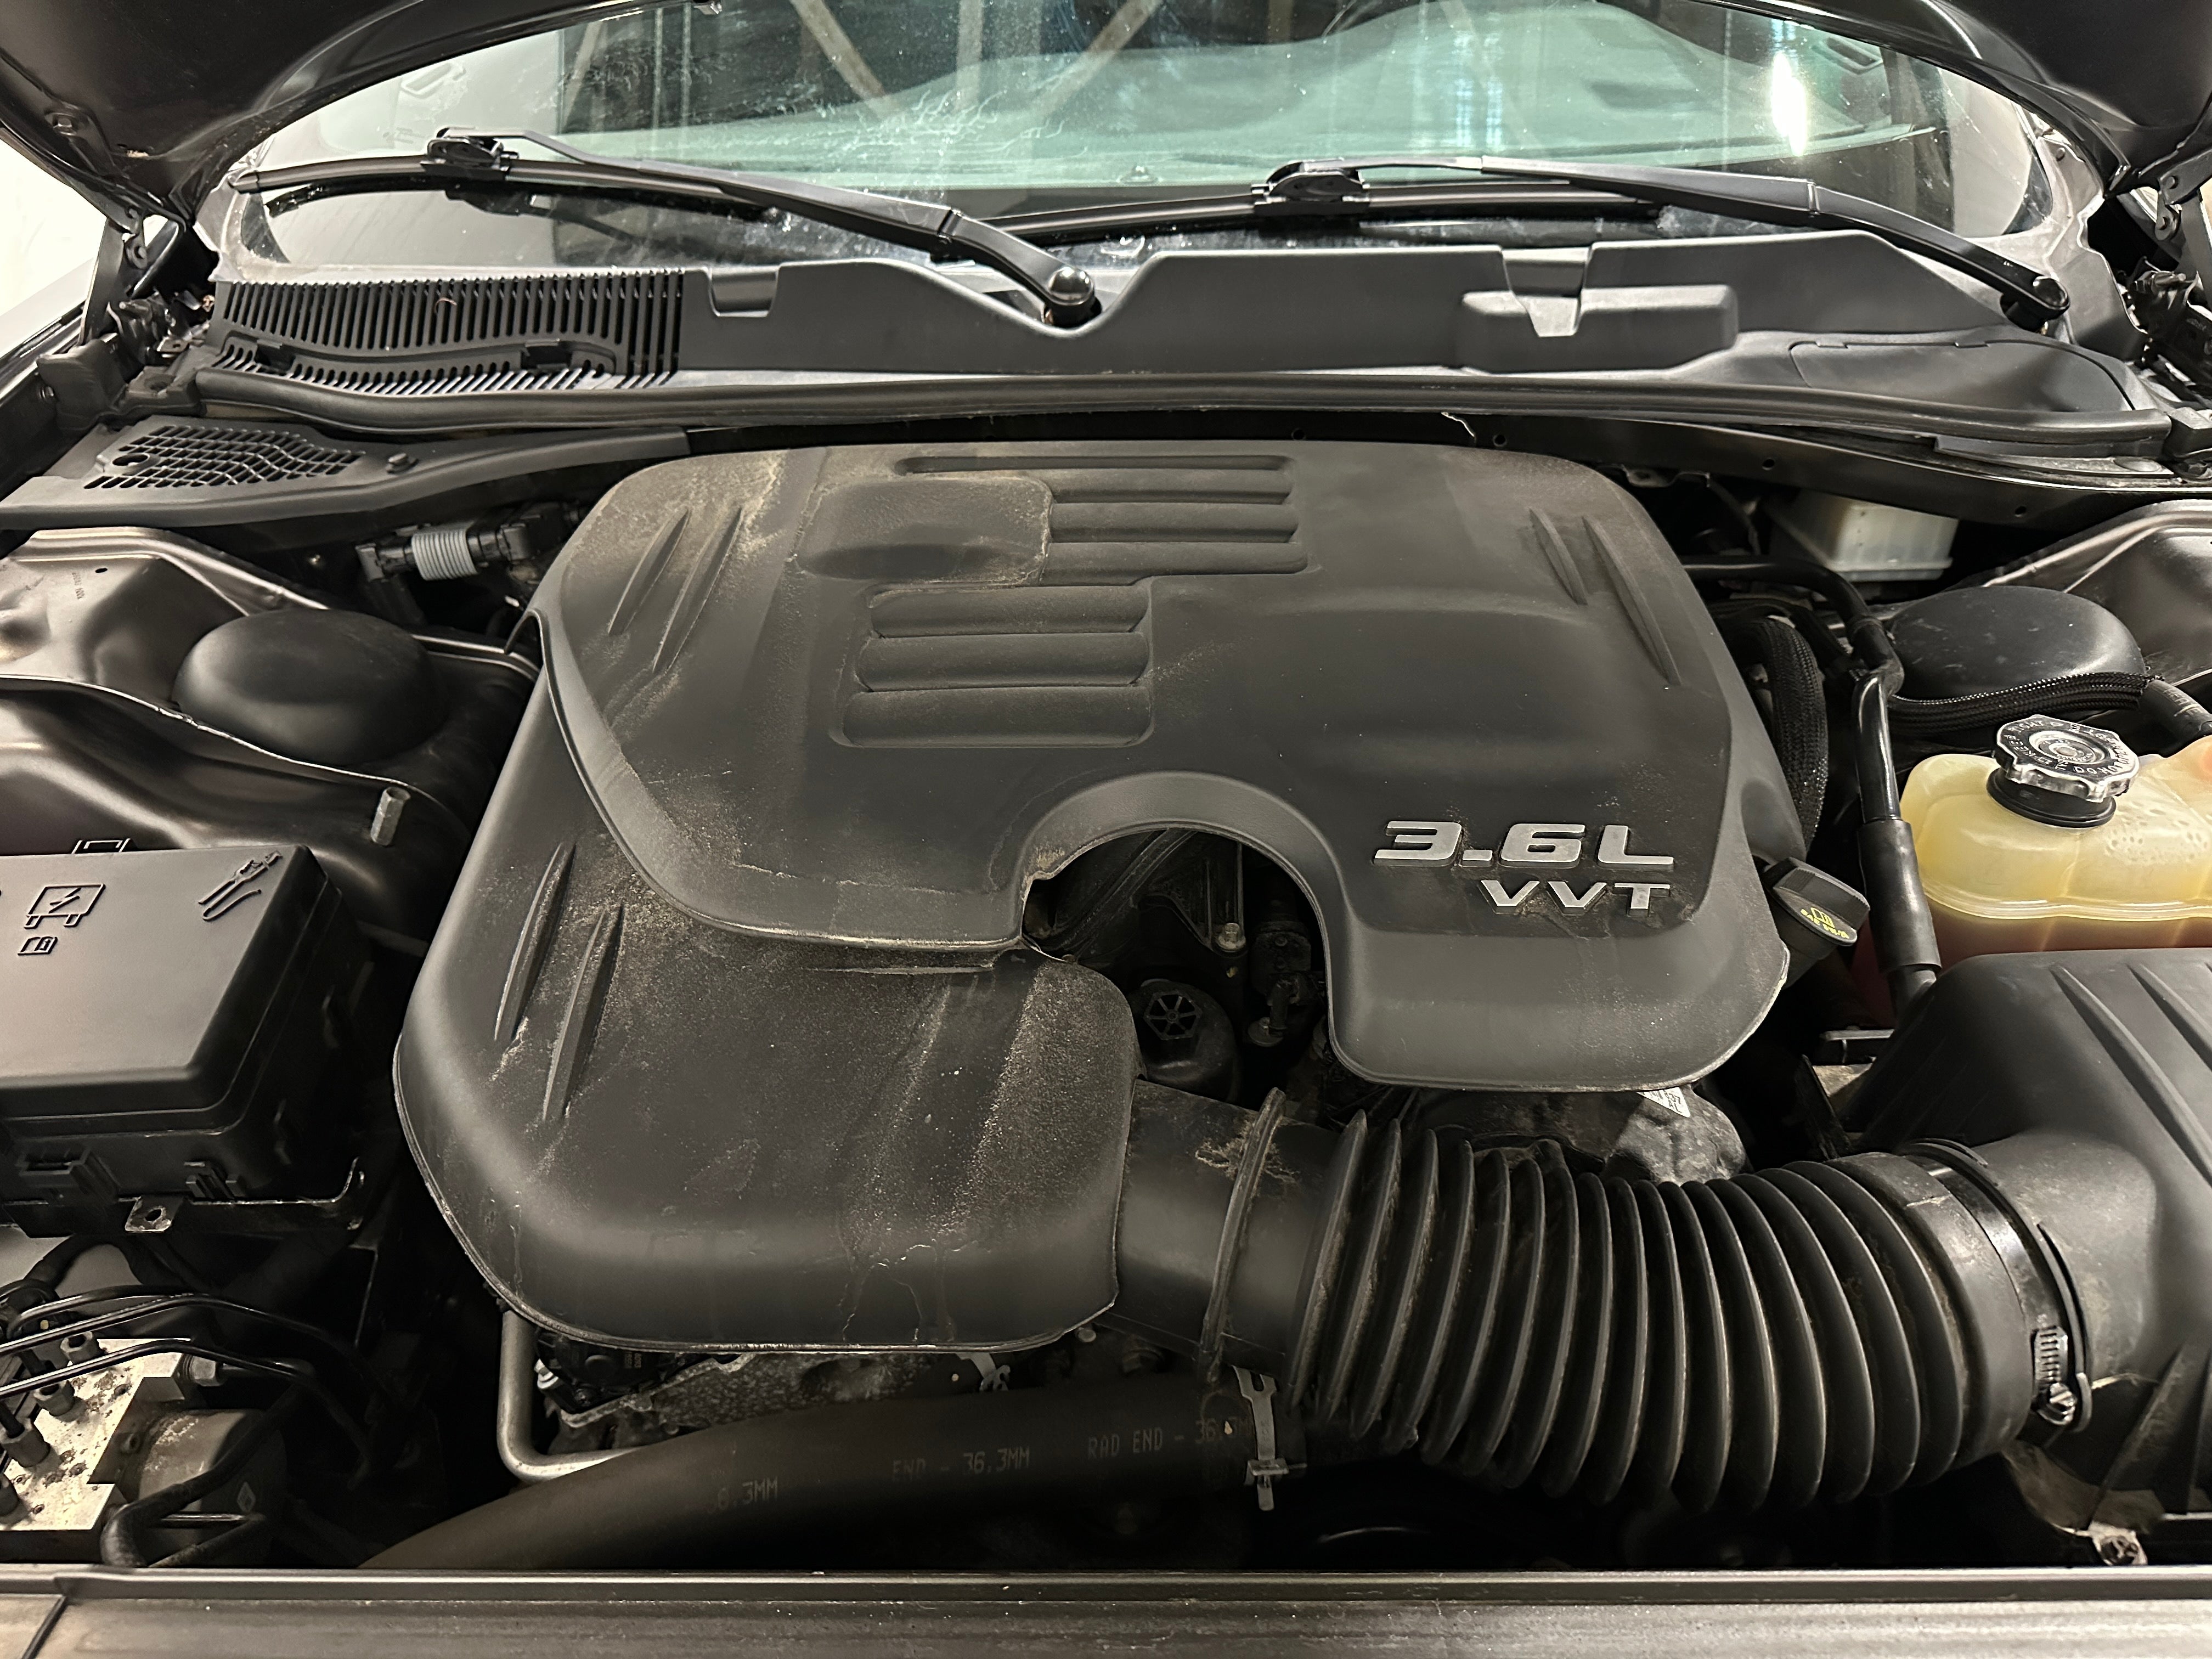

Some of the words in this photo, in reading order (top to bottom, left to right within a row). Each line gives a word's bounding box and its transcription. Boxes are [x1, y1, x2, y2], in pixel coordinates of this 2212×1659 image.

[2003, 733, 2036, 758] KEEP
[2073, 765, 2097, 775] DO
[1373, 820, 1675, 870] 3.6L
[1479, 879, 1672, 916] VVT
[1087, 1434, 1120, 1460] RAD
[1132, 1427, 1164, 1453] END
[891, 1457, 927, 1483] END
